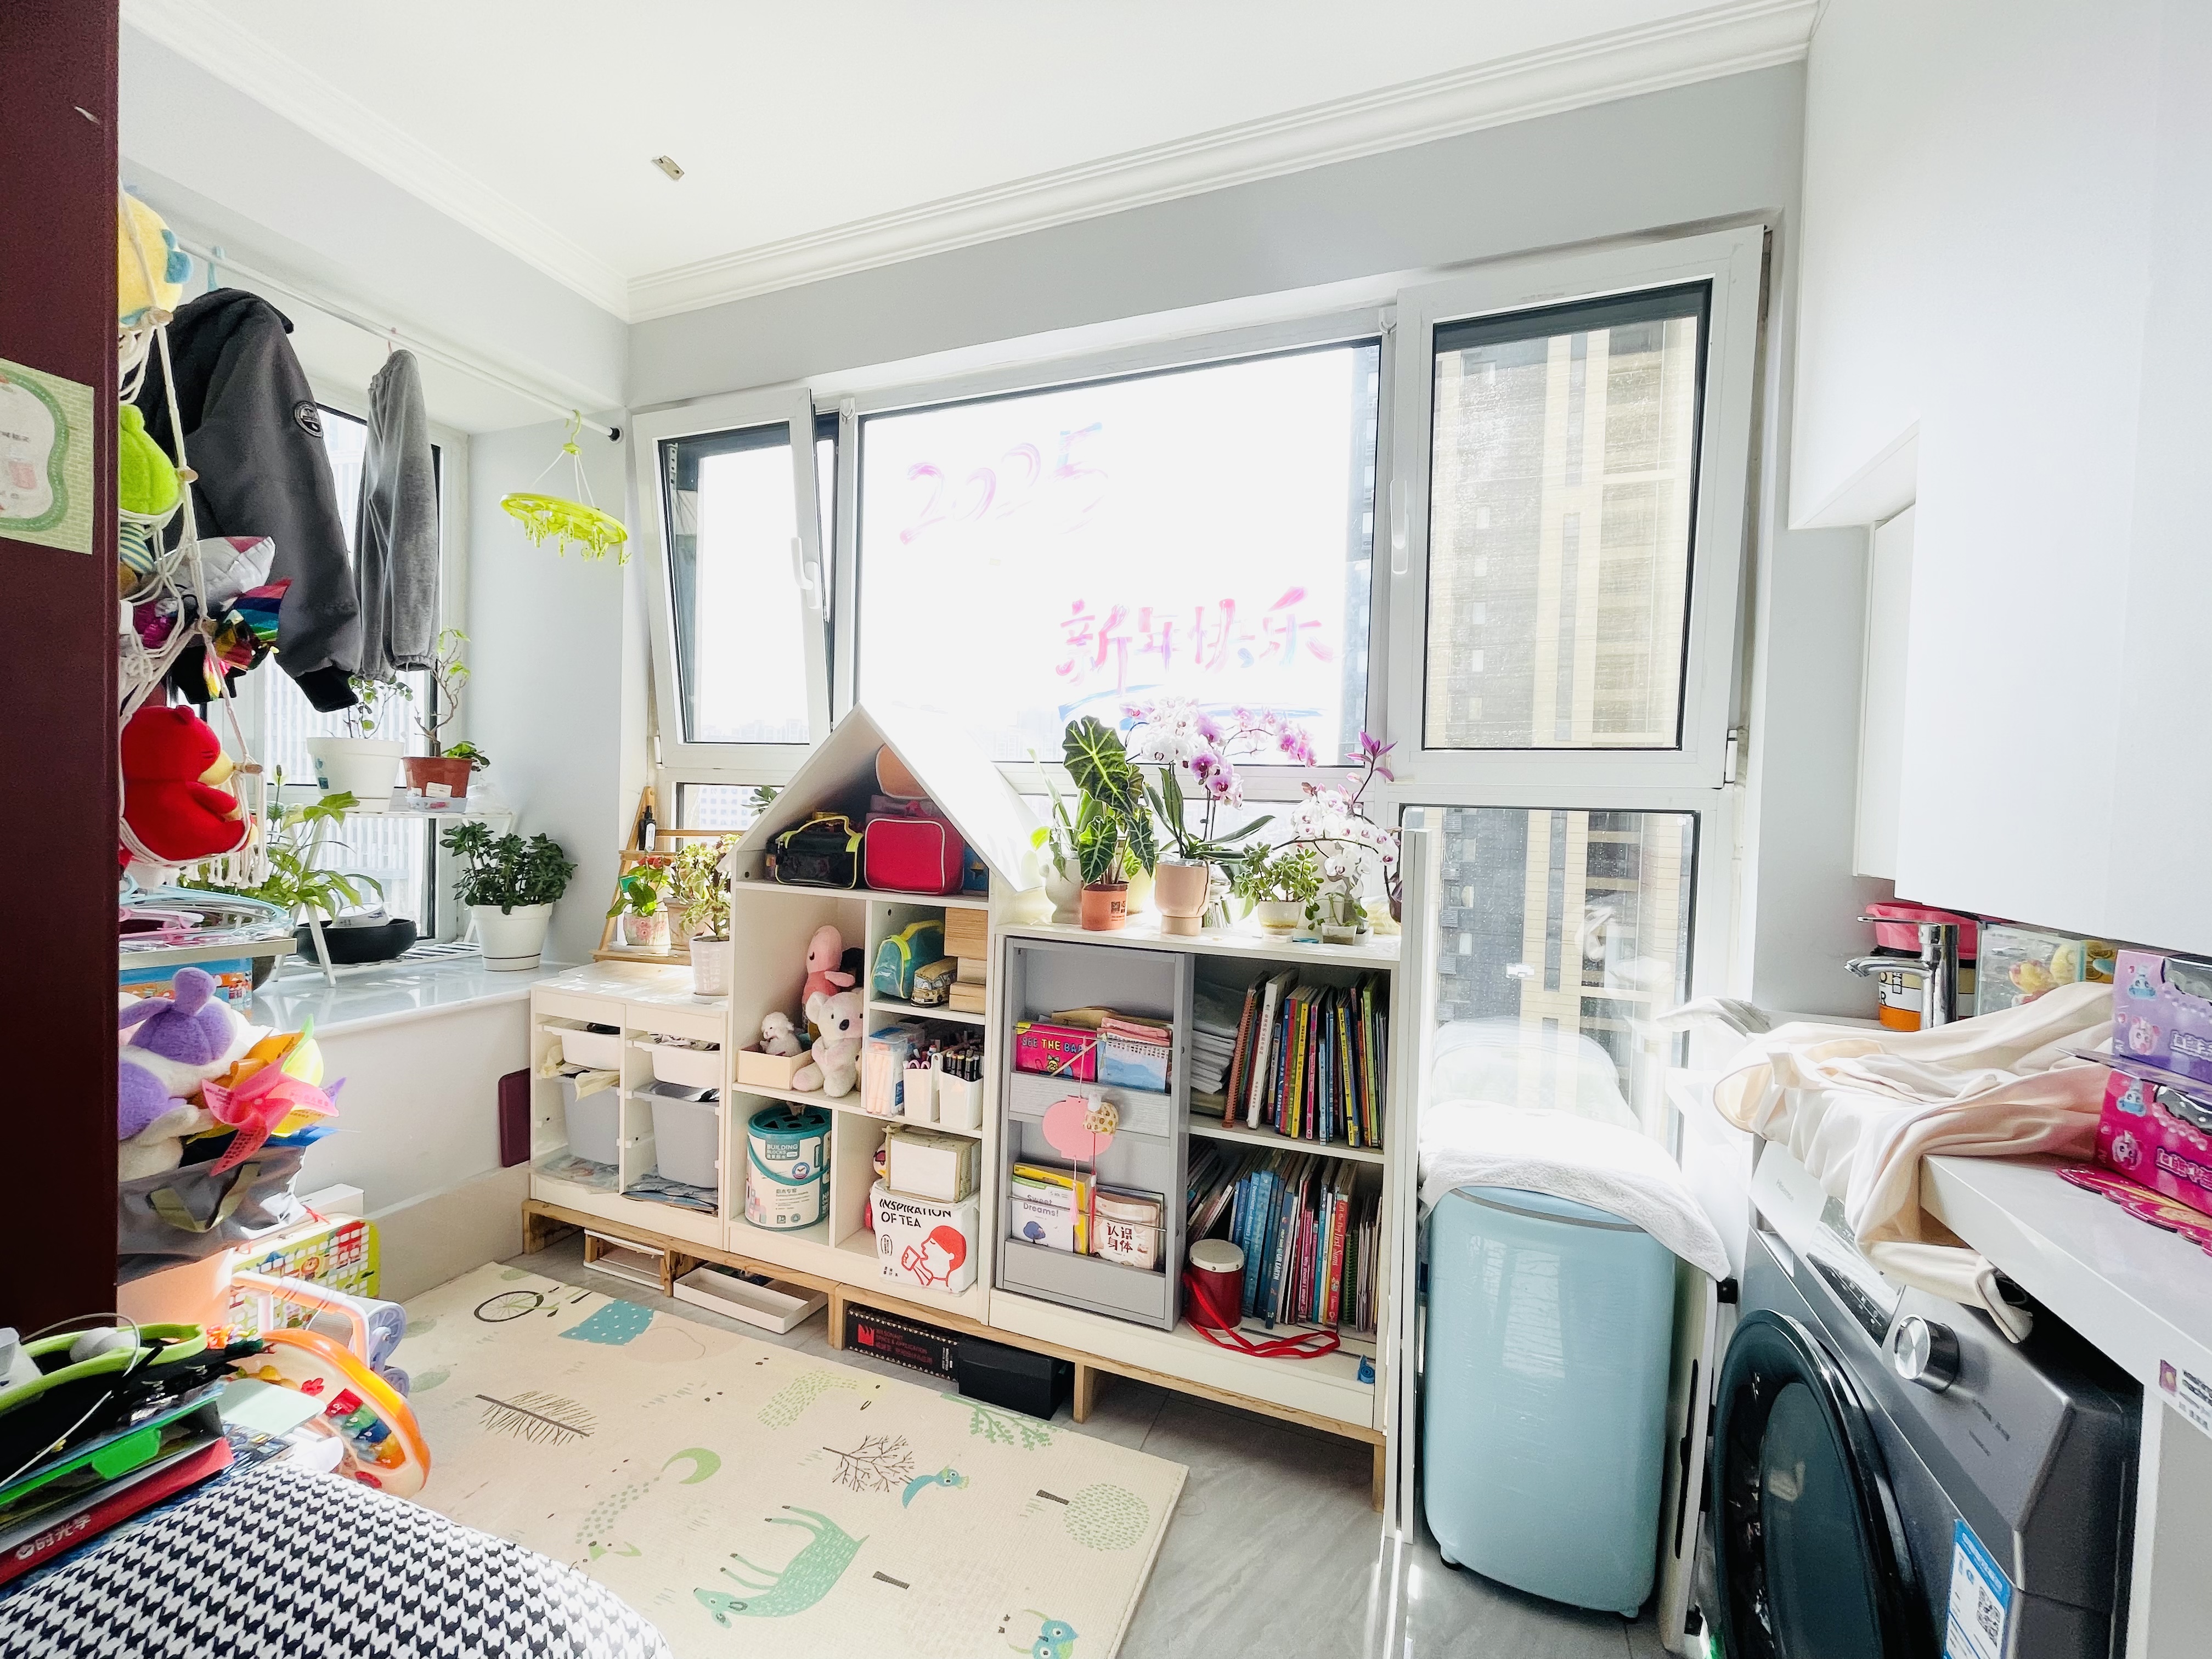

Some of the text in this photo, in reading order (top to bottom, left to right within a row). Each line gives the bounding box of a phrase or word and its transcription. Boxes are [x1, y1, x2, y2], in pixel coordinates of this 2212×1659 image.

[900, 421, 1108, 545] 2025
[1056, 586, 1334, 695] 新年快乐
[1022, 1036, 1090, 1056] SEE THE BAB
[1023, 1203, 1059, 1217] Dreams!
[881, 1211, 922, 1228] OF TEA
[1107, 1222, 1132, 1240] 认识
[1107, 1236, 1133, 1254] 身体
